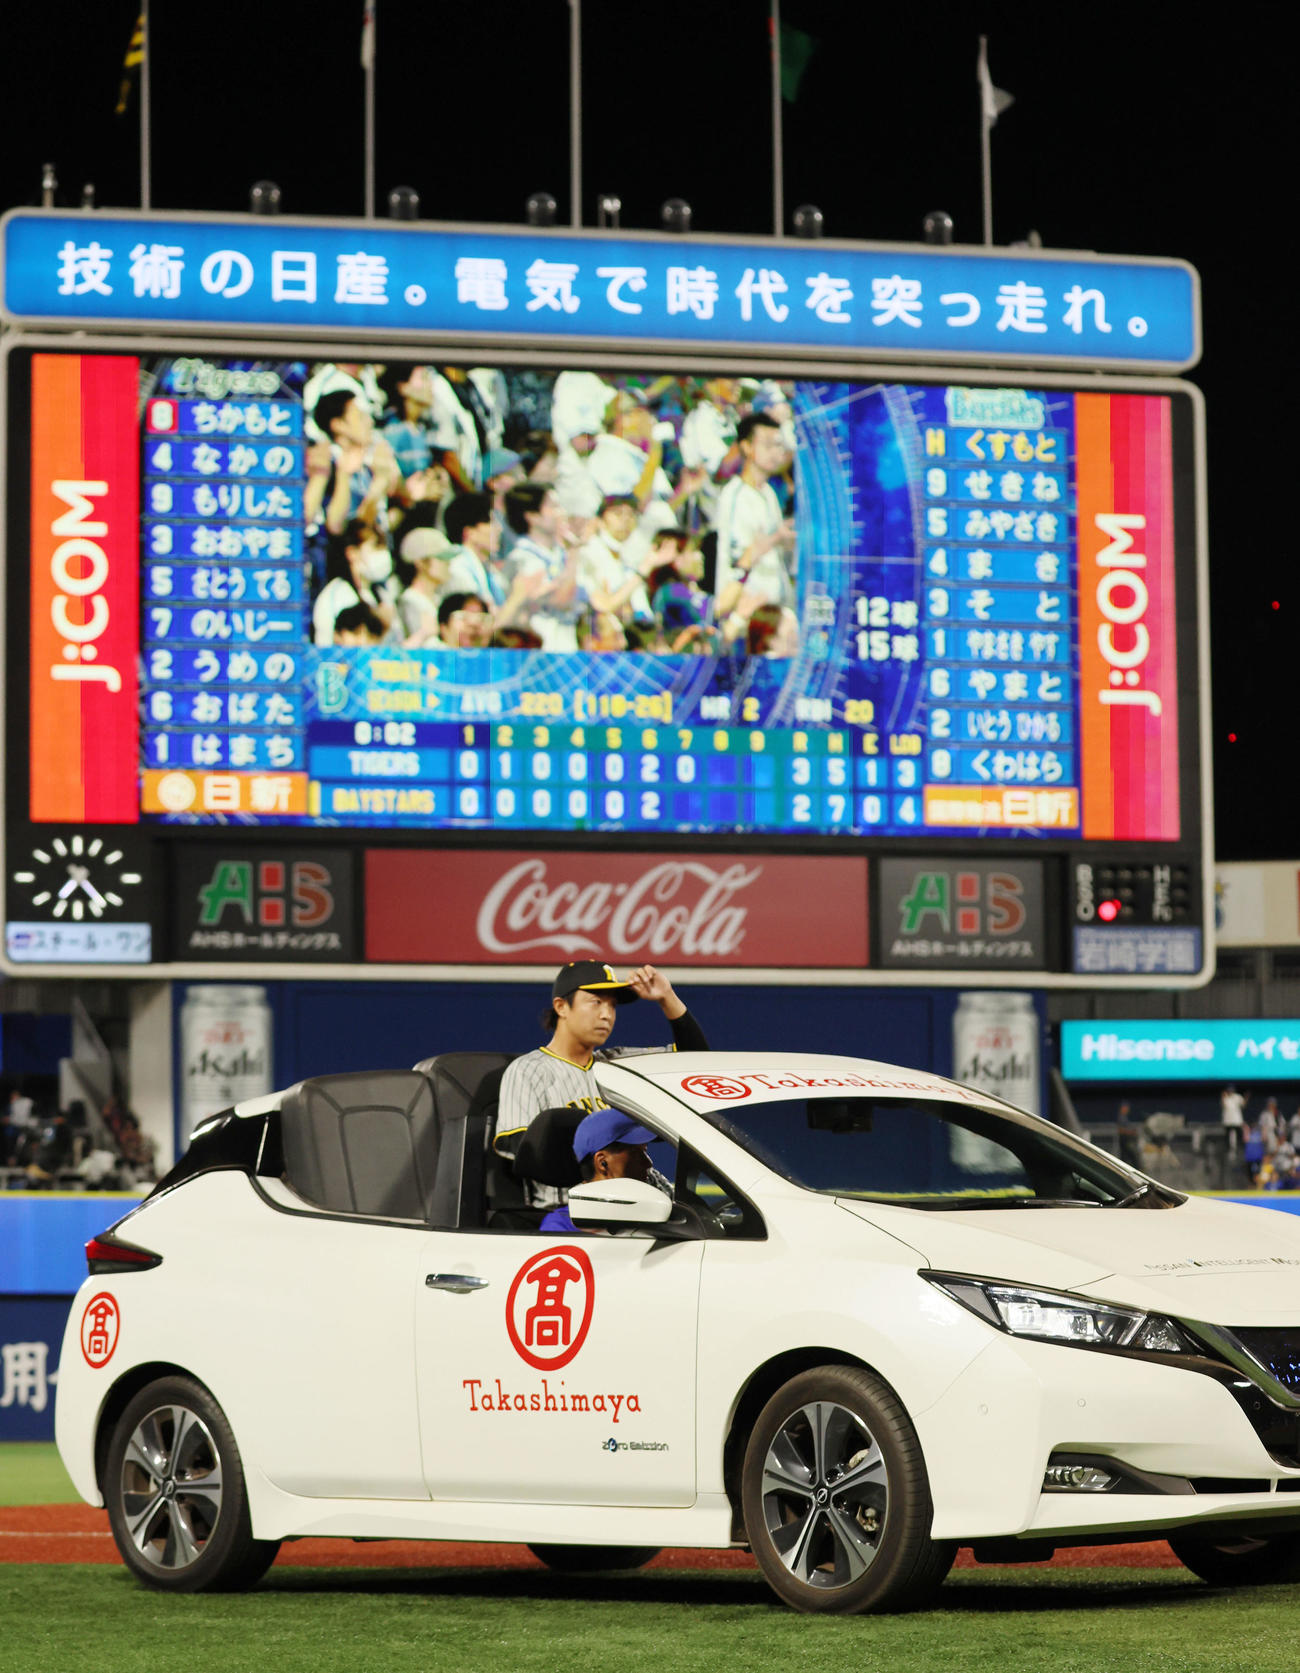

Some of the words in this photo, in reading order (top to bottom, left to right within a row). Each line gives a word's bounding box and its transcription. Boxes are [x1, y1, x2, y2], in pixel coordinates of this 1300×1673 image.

[57, 241, 1149, 337] 技術の日産。電気で時代を突っ走れ。
[191, 402, 291, 435] ちかもと
[152, 442, 173, 471] 4
[192, 443, 294, 475] なかの
[966, 429, 1056, 463] くすもと
[152, 483, 173, 513] 9
[192, 484, 292, 518] もりした
[927, 468, 947, 497] 9
[965, 470, 1060, 502] せきね
[927, 508, 948, 537] 5
[152, 525, 173, 554] 3
[191, 525, 292, 558] おおやま
[929, 548, 948, 576] 4
[151, 566, 173, 596] 5
[929, 588, 949, 617] 3
[152, 607, 172, 637] 7
[191, 609, 293, 641] のいじー
[933, 628, 946, 658] 1
[152, 649, 173, 679] 2
[194, 650, 295, 682] うめの
[930, 668, 950, 697] 6
[968, 669, 1062, 702] やまと
[152, 691, 173, 722] 6
[191, 691, 294, 725] おばた
[742, 696, 760, 721] 2
[930, 708, 951, 738] 2
[155, 733, 169, 763] 1
[192, 734, 294, 766] はまち
[464, 724, 475, 746] 1
[497, 725, 514, 747] 2
[533, 726, 550, 748] 3
[570, 727, 585, 747] 4
[606, 728, 621, 749] 5
[642, 729, 658, 749] 6
[678, 729, 693, 749] 7
[460, 750, 479, 779] 0
[498, 751, 512, 779] 1
[533, 752, 551, 780] 0
[568, 752, 587, 780] 0
[605, 753, 624, 782] 0
[640, 754, 660, 782] 2
[677, 755, 696, 783] 0
[792, 757, 811, 785] 3
[826, 758, 846, 786] 5
[866, 759, 877, 786] 1
[897, 759, 916, 787] 3
[971, 750, 1063, 782] くわはら
[460, 788, 479, 817] 0
[496, 789, 515, 817] 0
[533, 789, 551, 817] 0
[568, 789, 587, 818] 0
[605, 790, 624, 819] 0
[640, 791, 660, 819] 2
[793, 794, 811, 822] 2
[827, 794, 846, 822] 7
[863, 795, 881, 823] 0
[898, 796, 917, 824] 4
[477, 858, 763, 956] Coca-Cola
[463, 1379, 642, 1424] Takashimaya
